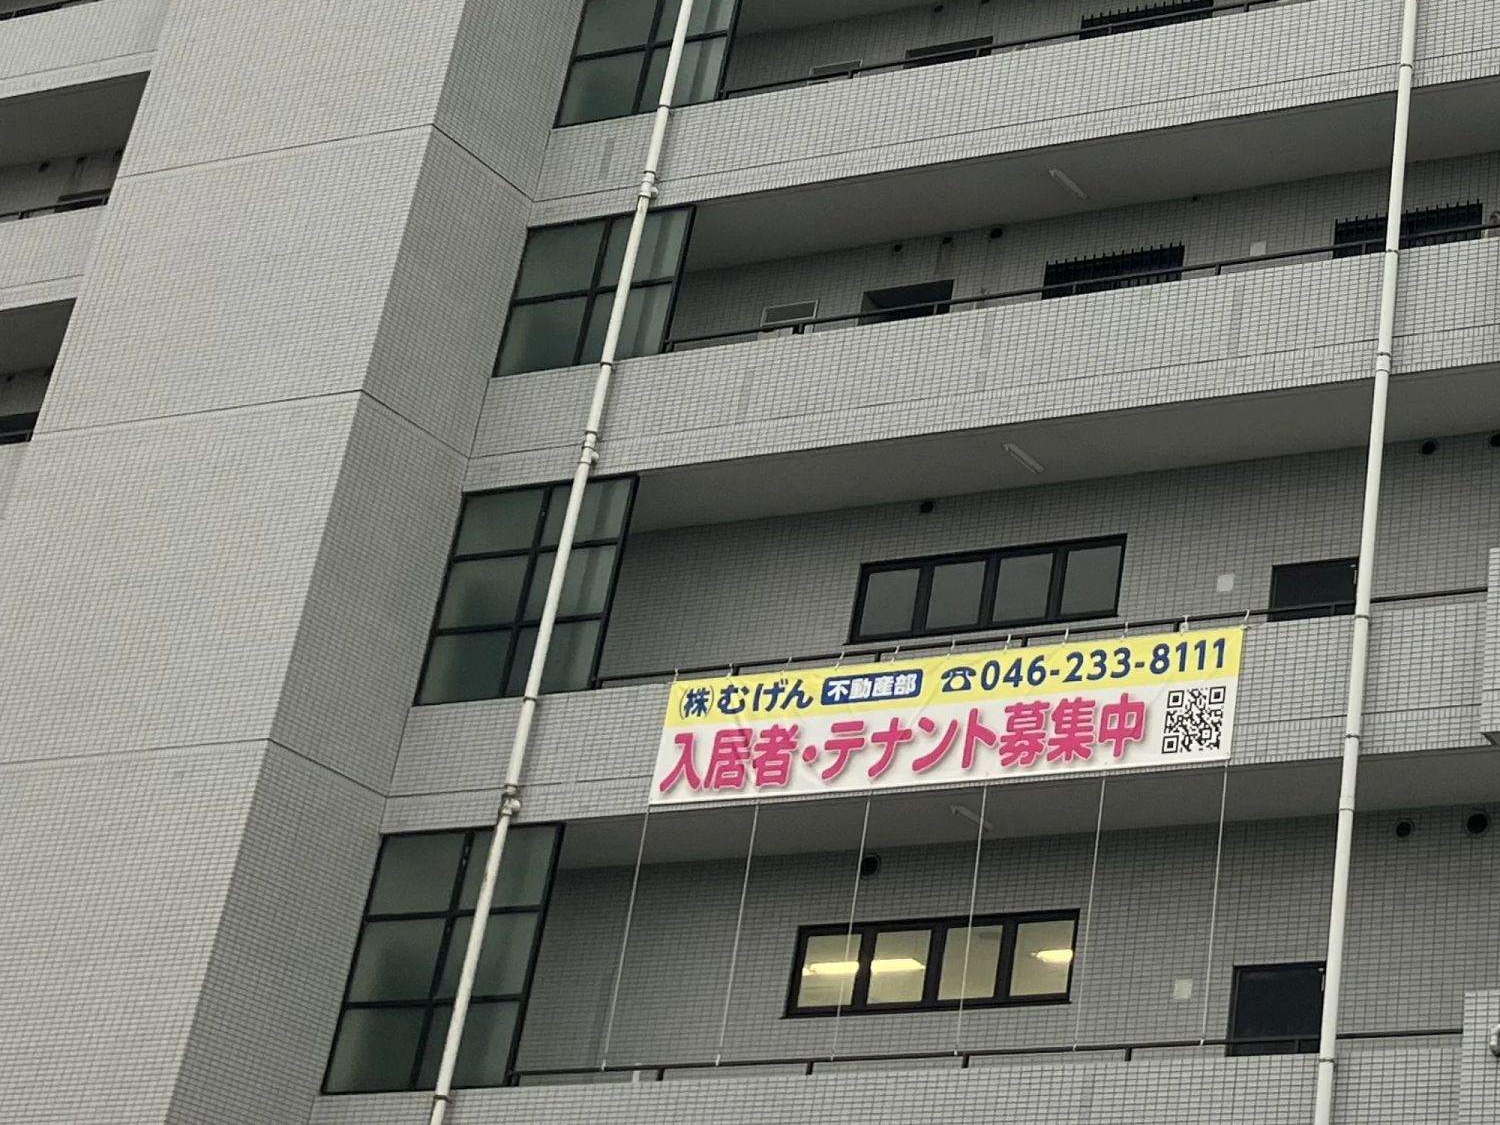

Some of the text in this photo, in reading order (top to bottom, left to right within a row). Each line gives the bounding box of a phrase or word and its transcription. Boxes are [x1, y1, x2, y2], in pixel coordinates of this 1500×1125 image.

[827, 673, 918, 702] 不動産部
[980, 637, 1226, 692] 046-233-8111
[659, 691, 1146, 793] 入居者・テナント募集中
